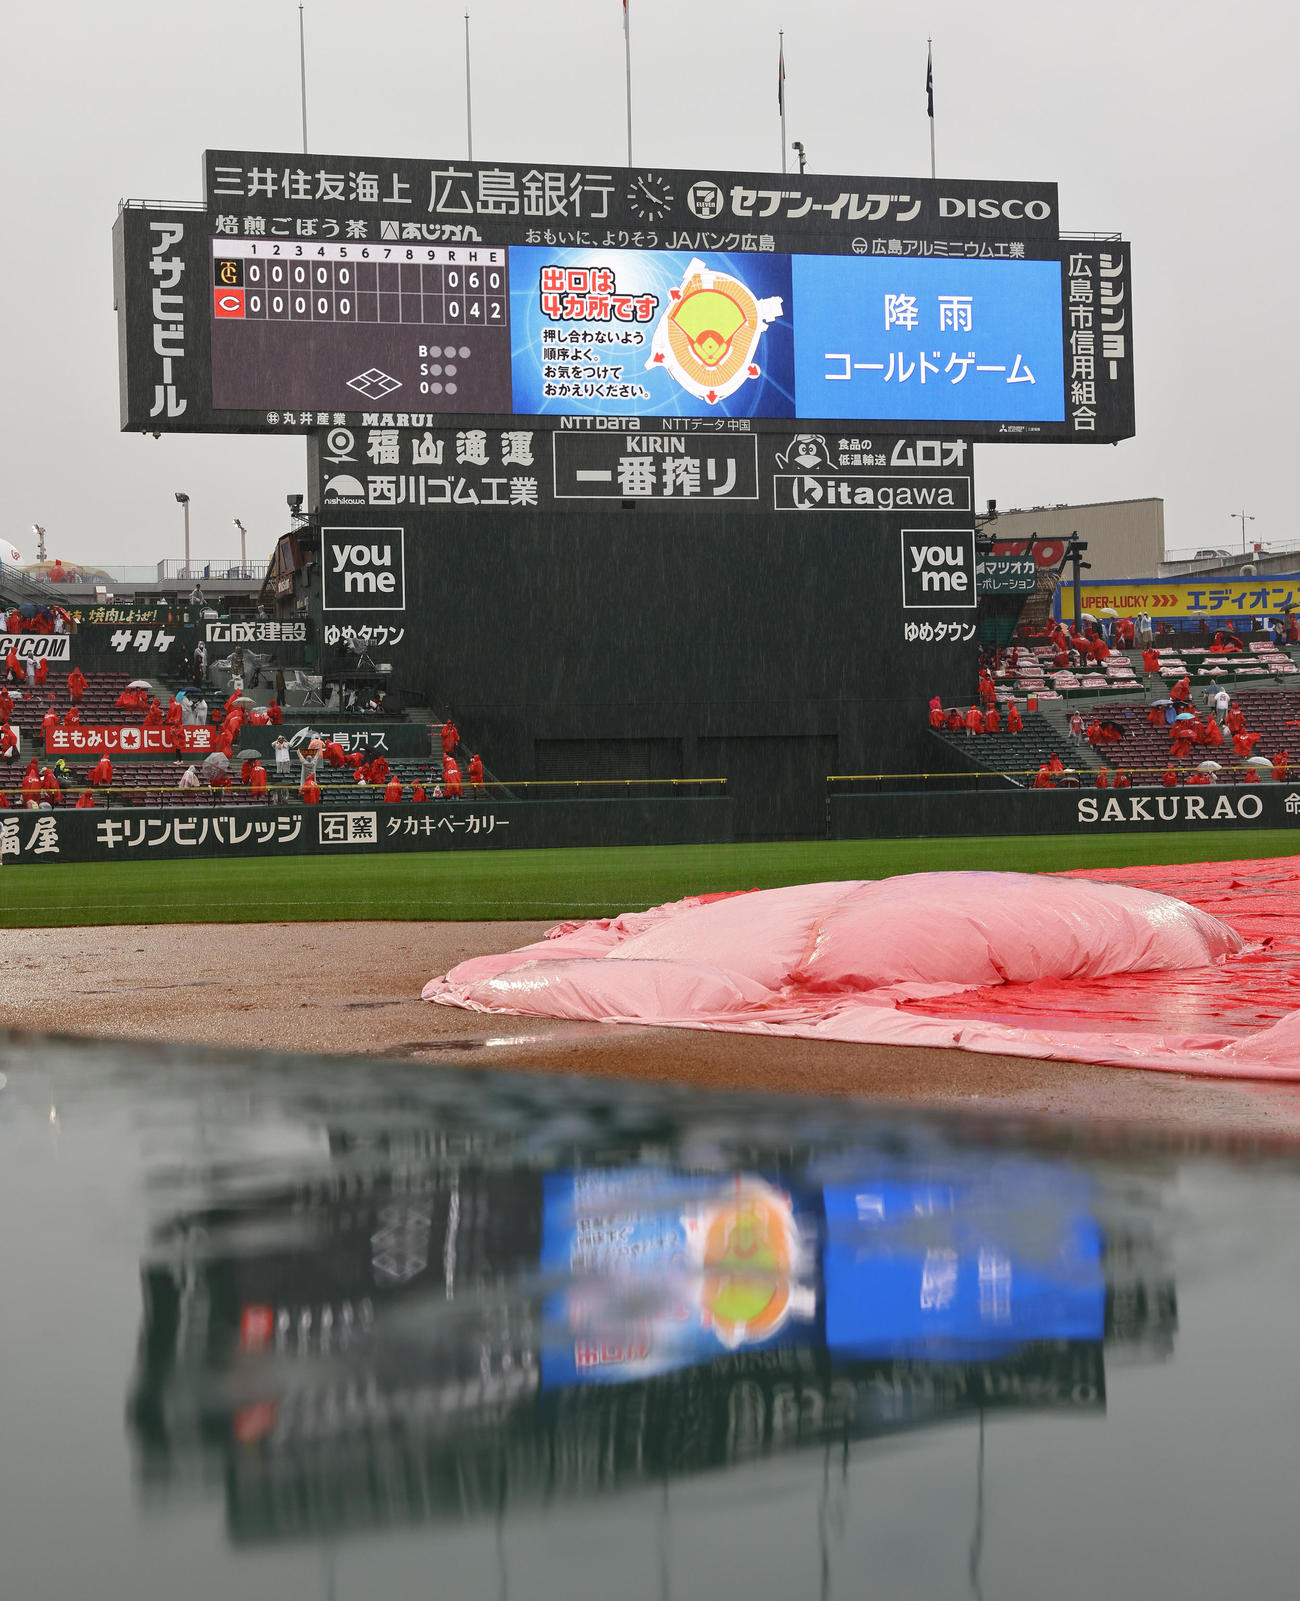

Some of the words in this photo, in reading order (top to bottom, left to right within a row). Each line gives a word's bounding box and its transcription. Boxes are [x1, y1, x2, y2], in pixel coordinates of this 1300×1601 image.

[214, 167, 412, 203] 三井住友海上
[428, 167, 615, 218] 広島銀行
[939, 197, 1051, 220] DISCO
[215, 214, 368, 239] 焙煎ごぼう茶
[401, 222, 482, 242] あじかん
[666, 231, 775, 252] JAバンク広島
[871, 238, 1025, 259] 広島アルミニウム工業
[251, 244, 256, 254] 1
[273, 245, 280, 255] 2
[295, 246, 302, 256] 3
[318, 247, 325, 256] 4
[340, 248, 347, 257] 5
[362, 248, 369, 258] 6
[384, 249, 392, 258] 7
[406, 250, 413, 260] 8
[428, 250, 435, 260] 9
[449, 251, 456, 261] R
[470, 252, 477, 262] H
[490, 252, 496, 262] E
[250, 265, 260, 281] 0
[272, 266, 282, 282] 0
[294, 267, 305, 282] 0
[317, 268, 327, 283] 0
[340, 268, 350, 284] 0
[448, 272, 458, 287] 0
[469, 272, 480, 288] 6
[490, 273, 500, 288] 0
[541, 267, 615, 293] 出口は
[250, 296, 260, 312] 0
[273, 296, 283, 312] 0
[296, 297, 306, 313] 0
[318, 298, 328, 314] 0
[340, 298, 350, 314] 0
[449, 302, 459, 317] 0
[470, 302, 480, 318] 4
[491, 303, 500, 318] 2
[541, 294, 657, 320] 4カ所です
[149, 222, 188, 417] アサヒビール
[543, 330, 644, 344] 押し合わないよう
[1068, 253, 1096, 431] 広島市信用組合
[418, 346, 428, 357] B
[543, 348, 599, 362] 順序よく。
[420, 364, 428, 375] S
[544, 365, 622, 379] お気をつけて
[824, 351, 1036, 385] コールドゲーム
[544, 383, 649, 398] おかえりください。
[283, 412, 346, 426] 丸井産業
[361, 413, 433, 428] MARUI
[366, 430, 535, 466] 福山通運
[626, 436, 685, 453] KIRIN
[838, 438, 872, 450] 食品の
[890, 439, 967, 467] ムロオ
[838, 454, 886, 466] 低温輸送
[324, 497, 365, 505] nishikawa
[367, 475, 538, 506] 西川ゴム工業
[332, 545, 391, 572] you
[910, 546, 964, 573] you
[986, 562, 1035, 575] マツオカ
[344, 571, 396, 593] me
[922, 571, 968, 592] me
[1081, 594, 1148, 608] UPER-LUCKY
[1186, 587, 1300, 610] エディオン
[110, 630, 176, 652] サタケ
[206, 622, 307, 642] 広成建設
[324, 624, 405, 646] ゆめタウン
[904, 622, 976, 642] ゆめタウン
[0, 638, 66, 657] GICOM
[52, 730, 118, 748] 生もみじ
[320, 732, 388, 752] 島ガス
[1078, 794, 1263, 823] SAKURAO
[97, 815, 302, 848] キリンビバレッジ
[324, 816, 373, 840] 石窯
[386, 814, 510, 836] タカキベーカリー
